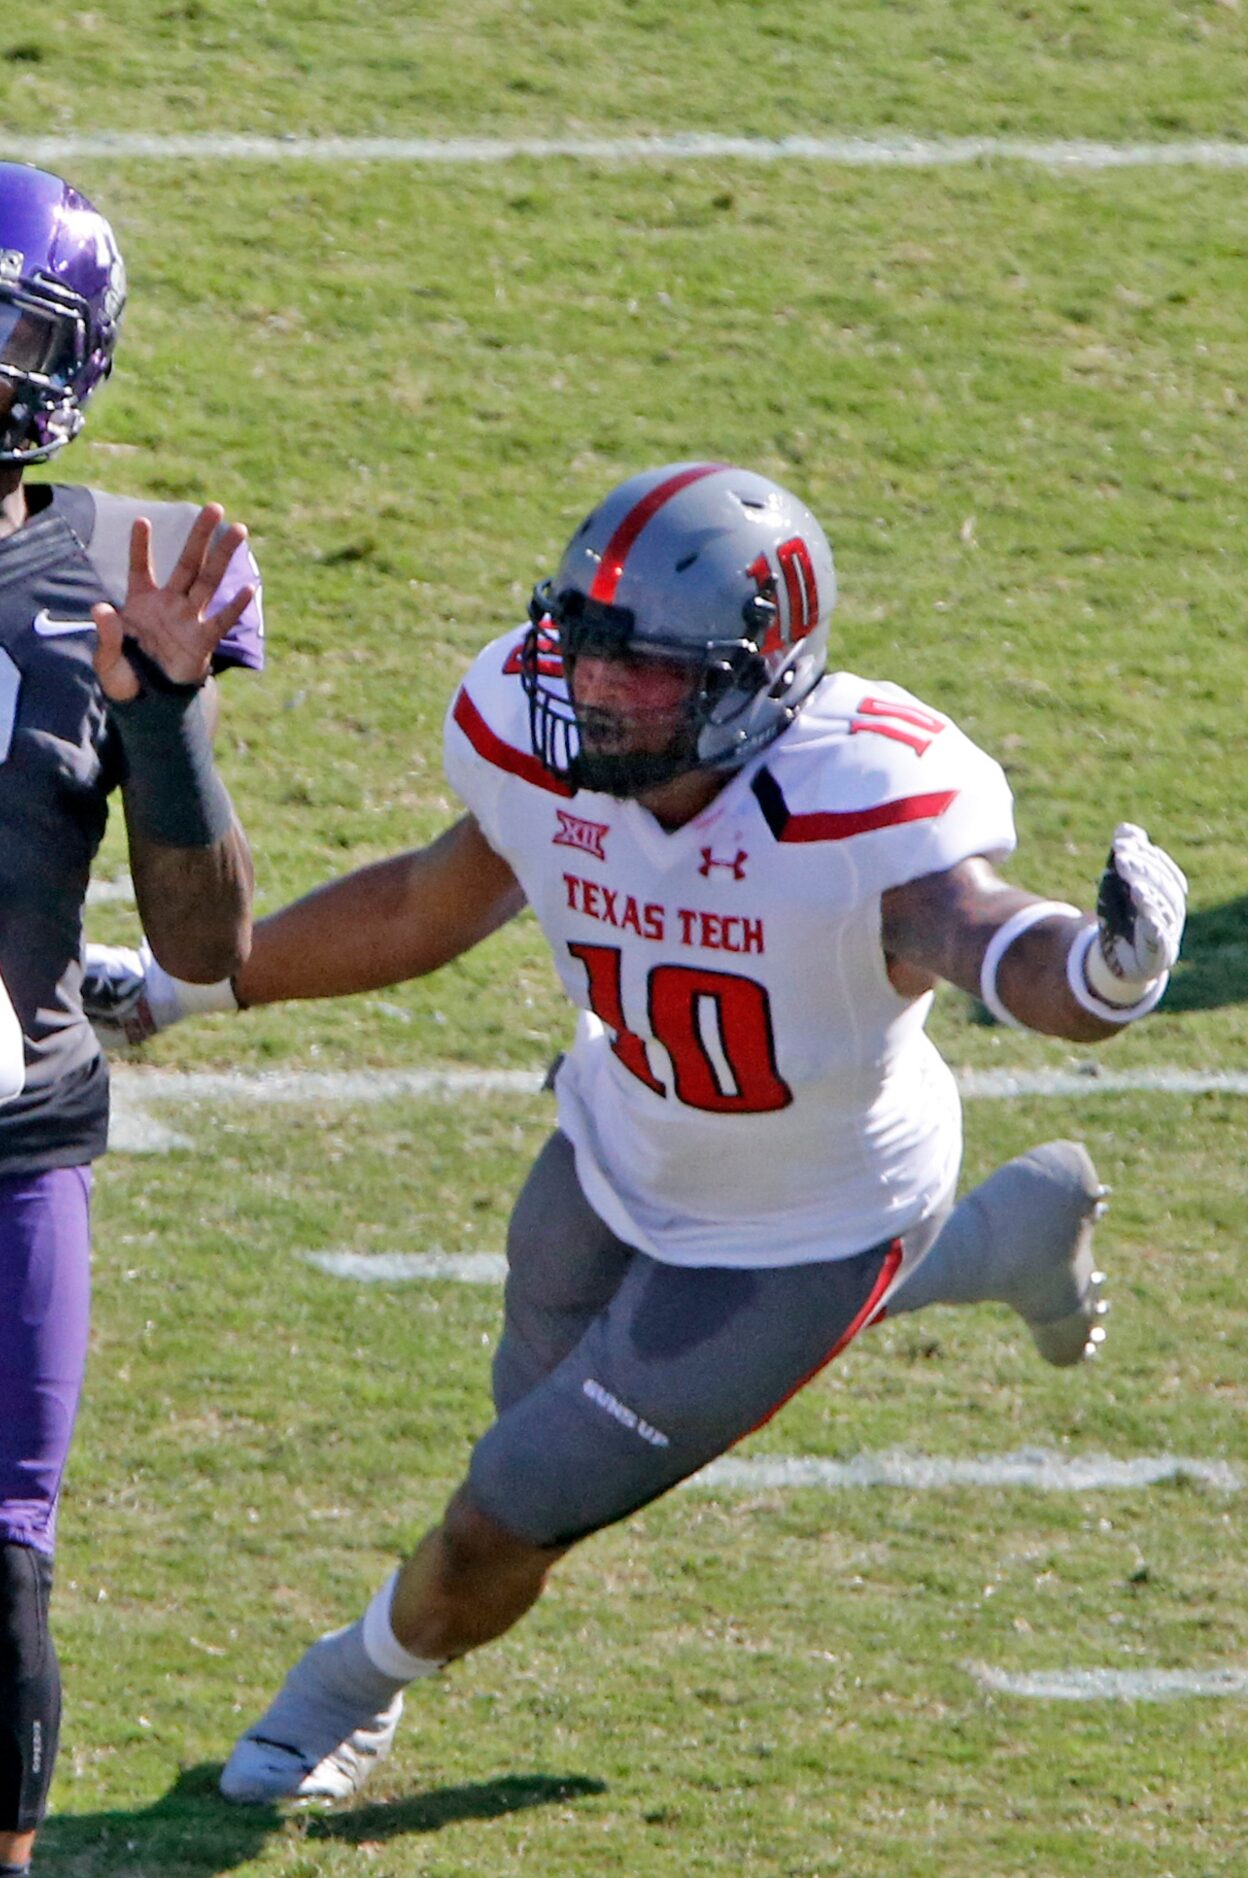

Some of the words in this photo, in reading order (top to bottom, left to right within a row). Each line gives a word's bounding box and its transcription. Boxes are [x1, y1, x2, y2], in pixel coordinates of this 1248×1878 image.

[745, 536, 819, 656] 10
[848, 697, 946, 757] 10
[563, 873, 664, 941] TEXAS
[677, 908, 765, 955] TECH
[566, 941, 793, 1114] 10
